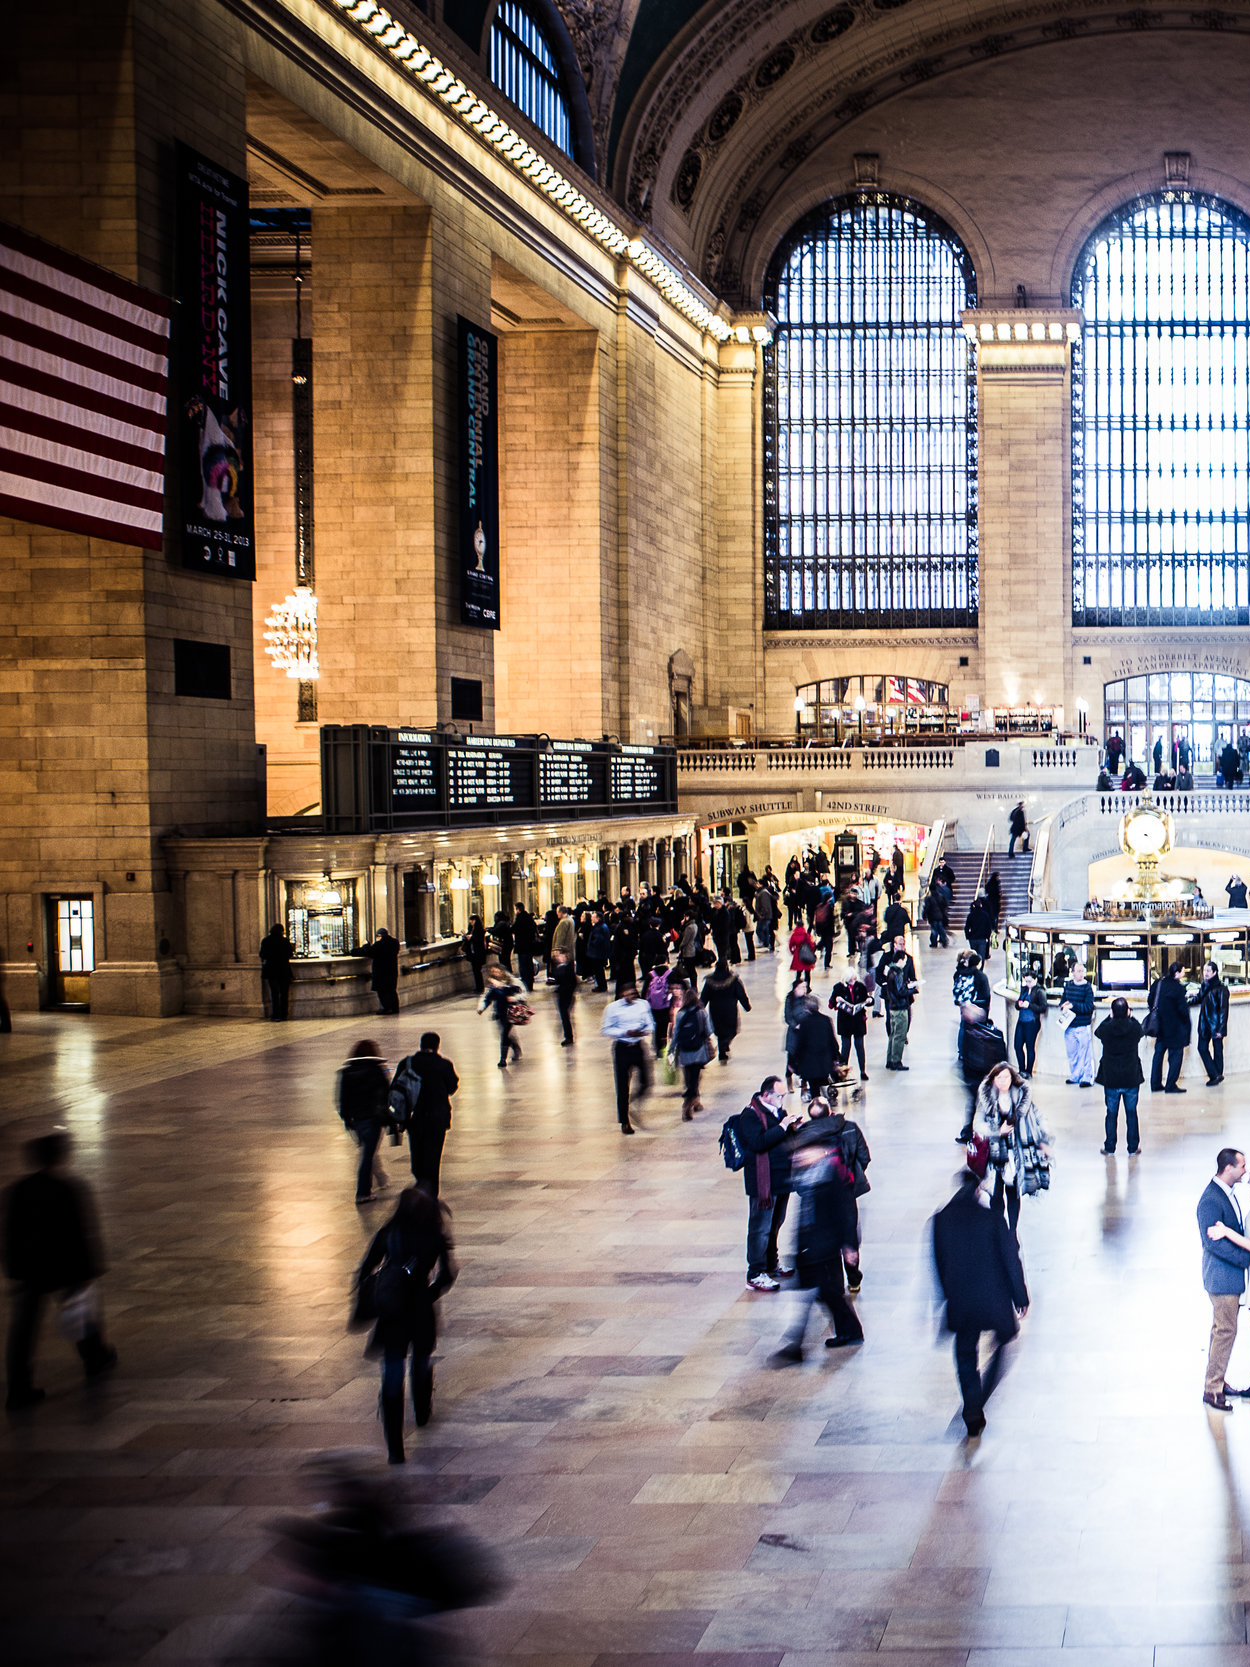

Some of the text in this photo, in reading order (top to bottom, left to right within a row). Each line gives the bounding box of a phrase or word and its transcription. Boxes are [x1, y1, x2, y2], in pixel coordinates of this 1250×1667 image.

[216, 209, 232, 401] NICK CAVE
[481, 339, 489, 417] GRAND
[474, 335, 483, 469] CENTENNIAL
[466, 331, 477, 510] GRAND CENTRAL
[185, 522, 212, 539] MARCH
[232, 534, 251, 548] 2013
[482, 608, 497, 621] CBRE
[1113, 660, 1249, 678] THE CAMPBELL APARTMENT
[1121, 652, 1242, 668] TO VANDERBILT AVENUE
[707, 800, 793, 821] SUBWAY SHUTTLE
[826, 801, 889, 815] 42ND STREET
[1131, 901, 1176, 911] Information
